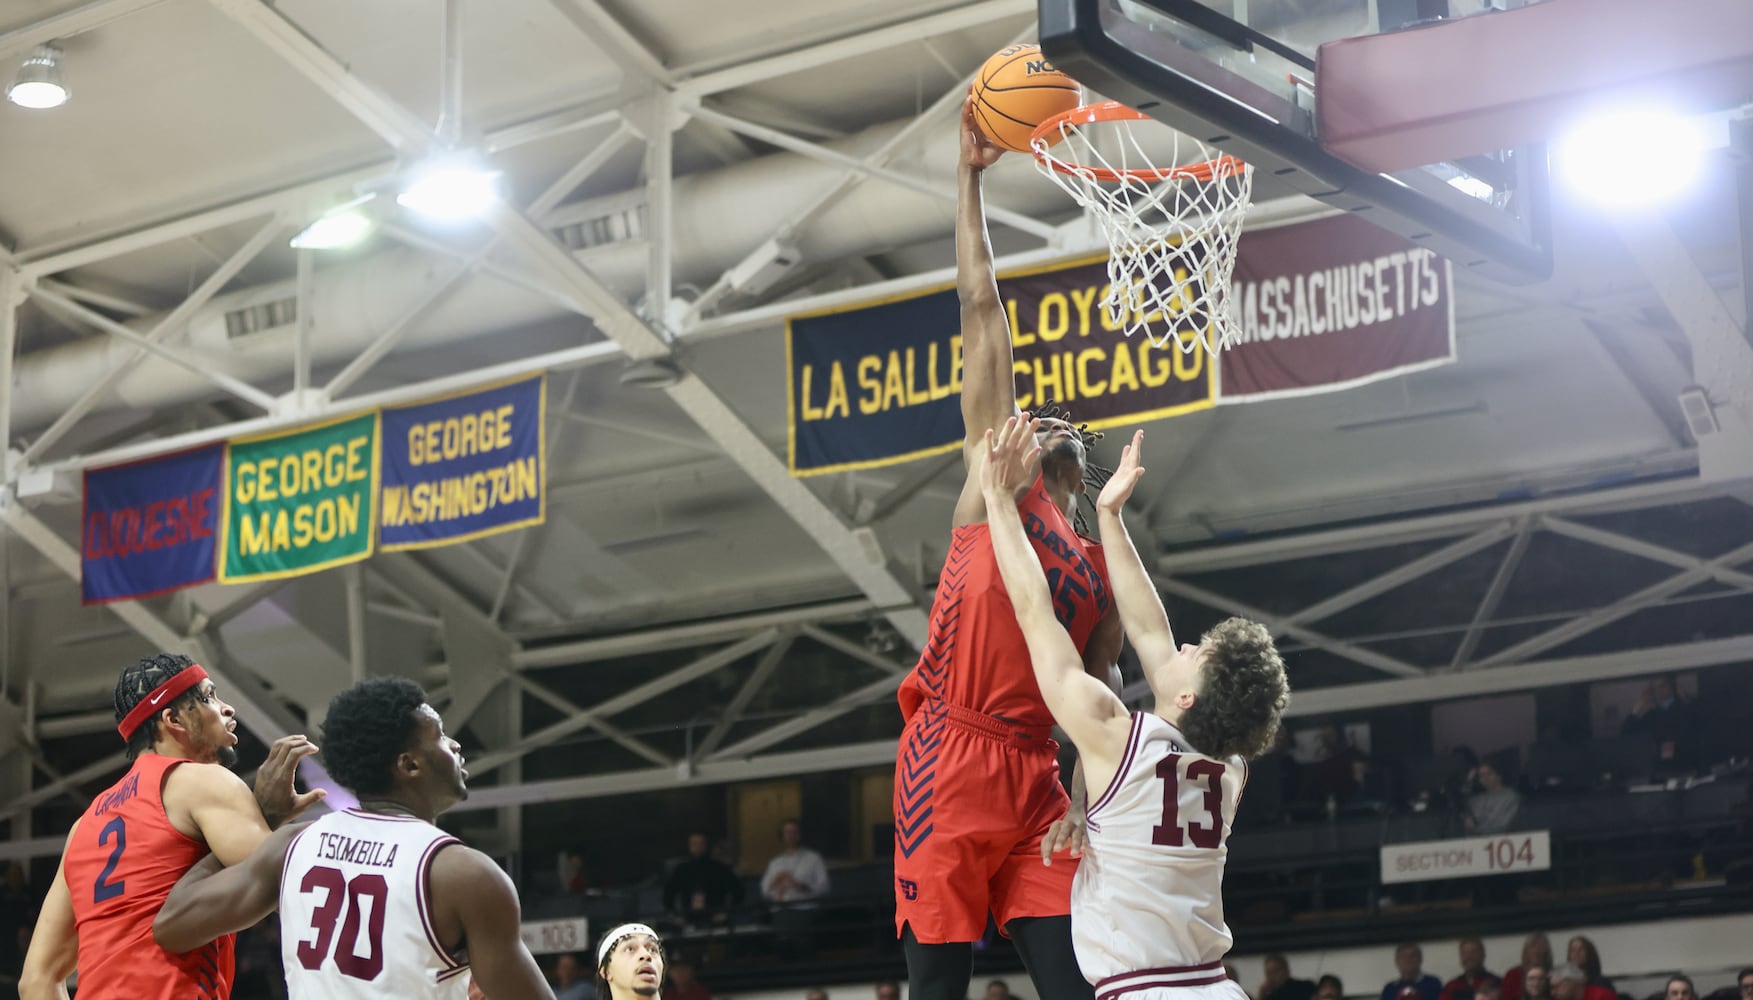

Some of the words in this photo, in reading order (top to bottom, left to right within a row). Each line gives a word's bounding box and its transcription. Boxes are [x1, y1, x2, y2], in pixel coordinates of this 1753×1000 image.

[1007, 266, 1196, 348] LOYOLA
[1229, 247, 1439, 346] MASSACHUSETTS
[802, 360, 850, 421] LA
[1012, 329, 1203, 410] CHICAGO
[236, 436, 367, 503] GEORGE
[408, 404, 515, 466] GEORGE
[86, 487, 214, 560] DUQUESNE
[240, 492, 360, 556] MASON
[382, 455, 537, 527] WASHINGTON
[1152, 753, 1226, 849] 13
[94, 816, 126, 904] 2
[317, 832, 399, 868] TSIMBILA
[1396, 850, 1473, 873] SECTION
[1484, 837, 1535, 869] 104
[297, 865, 389, 981] 30
[542, 923, 577, 951] 103
